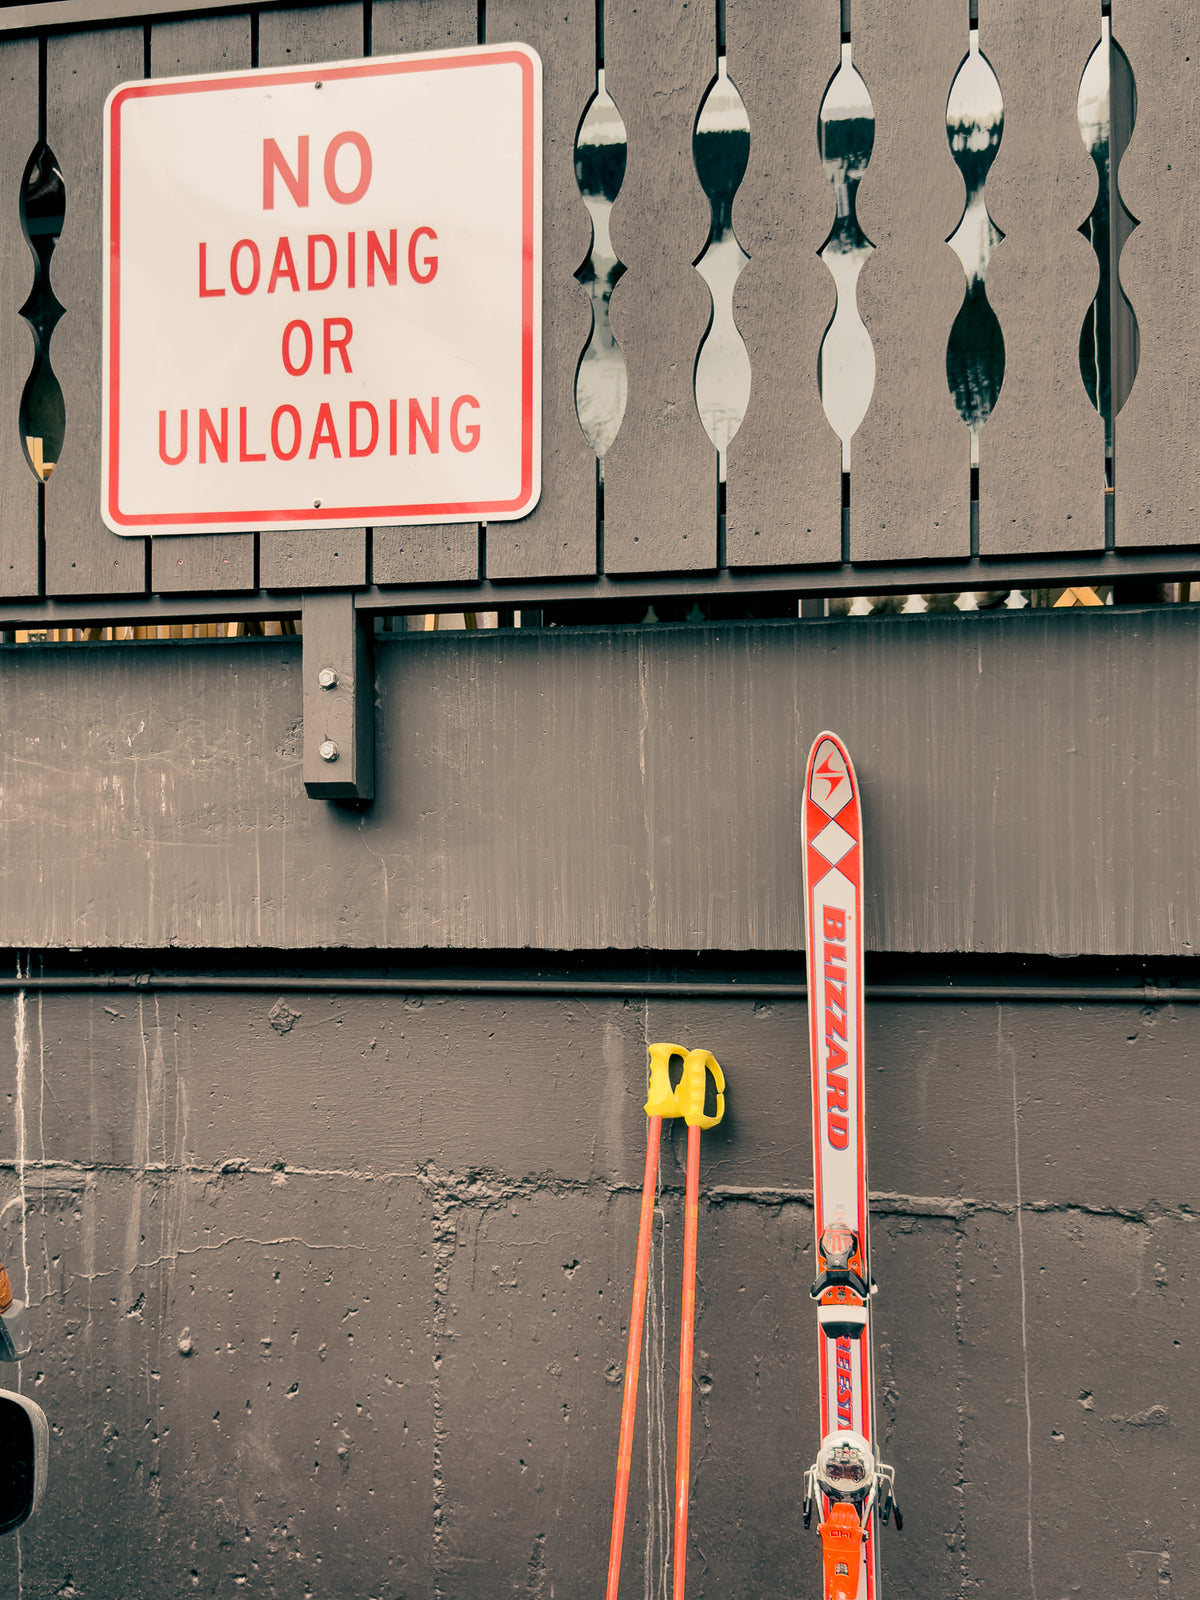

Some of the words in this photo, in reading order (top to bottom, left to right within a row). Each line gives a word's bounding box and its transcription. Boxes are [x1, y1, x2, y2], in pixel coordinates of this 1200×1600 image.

[262, 131, 373, 211] NO
[199, 226, 439, 299] LOADING
[281, 317, 354, 377] OR
[158, 394, 481, 466] UNLOADING
[823, 904, 850, 1151] BLIZZARD
